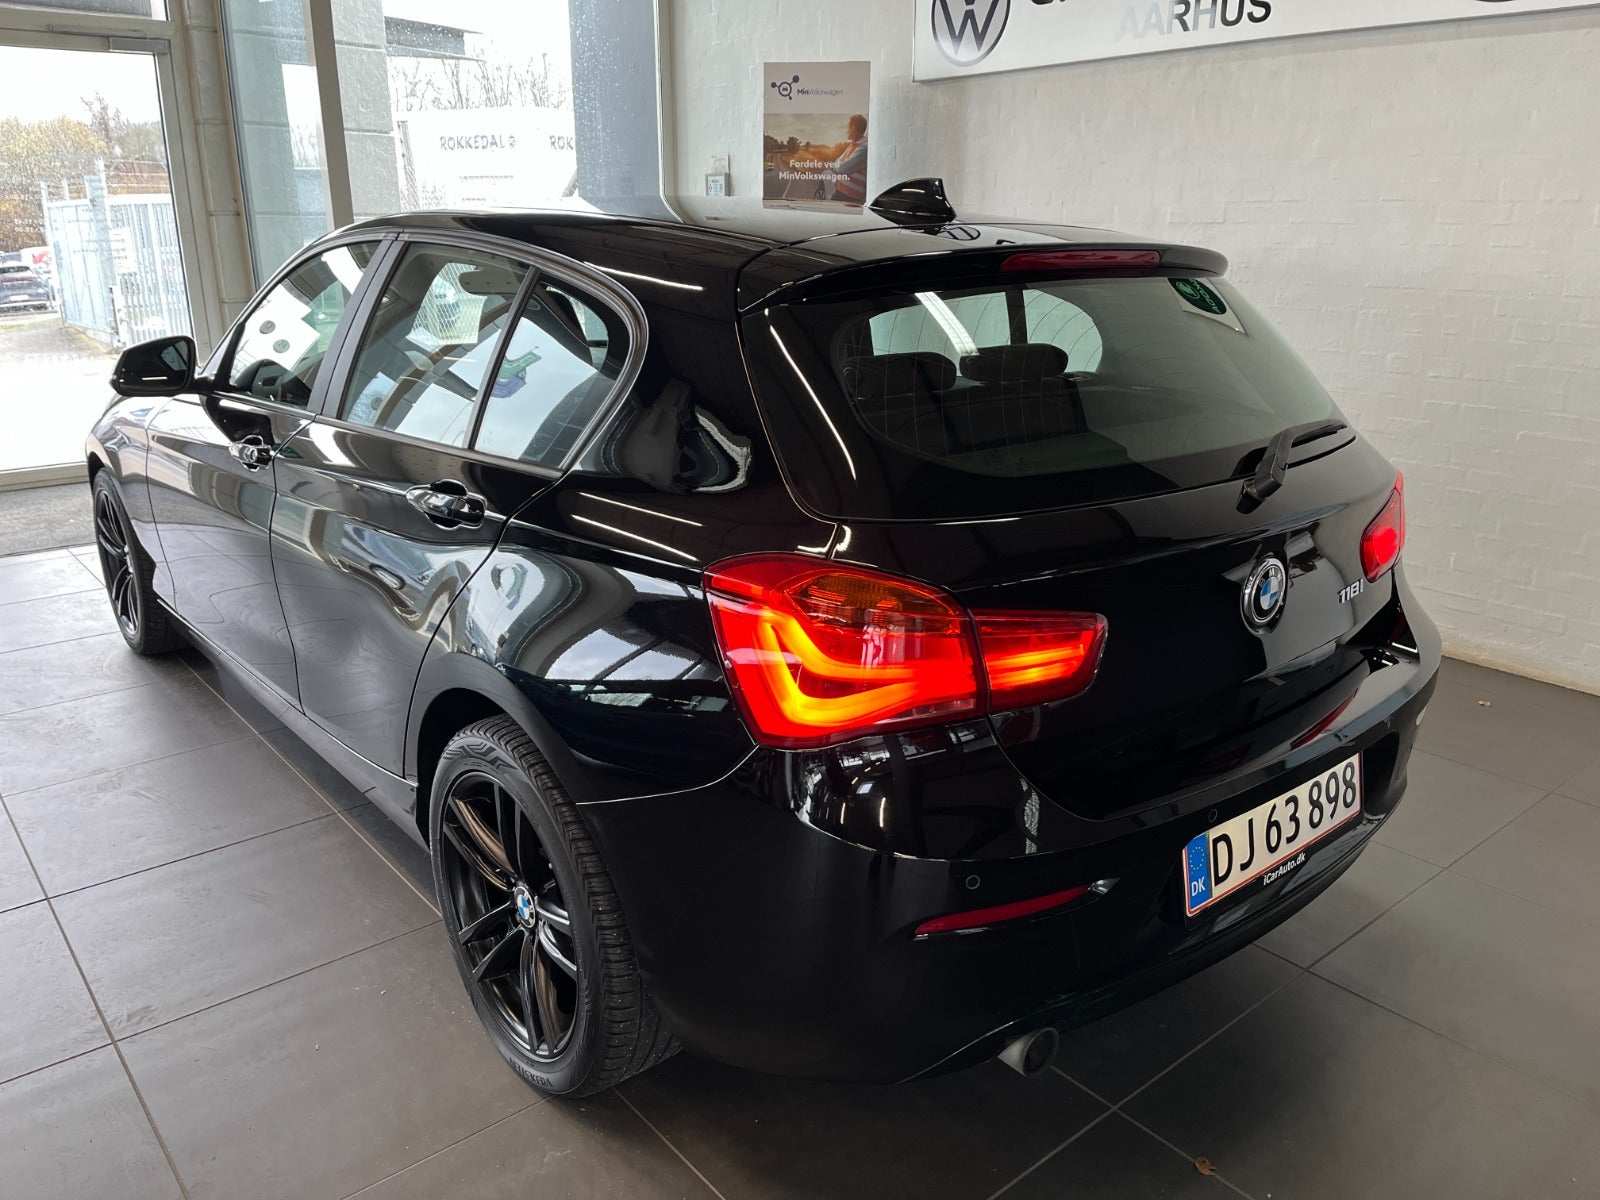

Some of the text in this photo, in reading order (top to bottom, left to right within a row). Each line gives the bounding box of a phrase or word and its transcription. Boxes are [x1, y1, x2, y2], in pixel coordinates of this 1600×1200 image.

[1115, 0, 1271, 41] AARHUS
[439, 135, 505, 150] ROKKEDAL
[789, 159, 840, 168] Fordele ved
[778, 171, 851, 182] MinVolkswagen.
[1211, 761, 1357, 887] DJ 63 898
[1263, 852, 1306, 886] iCarAuto.dk
[1191, 877, 1206, 897] DK
